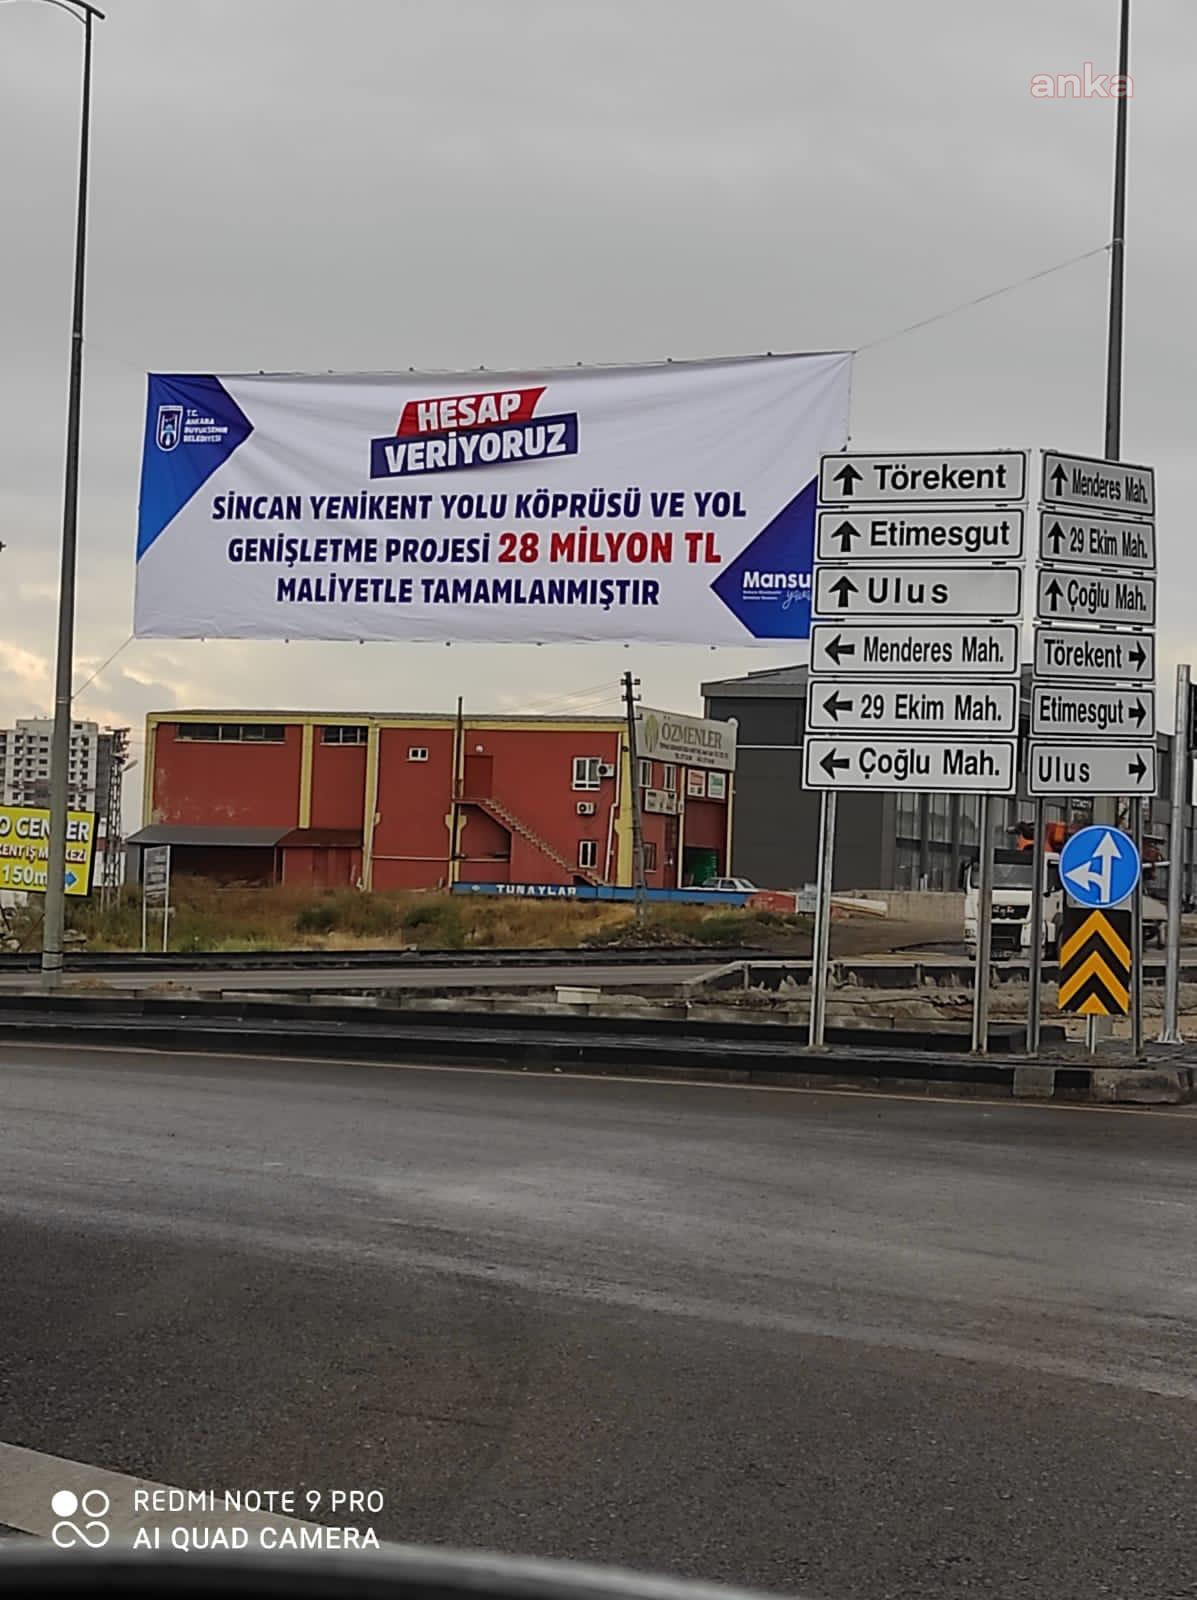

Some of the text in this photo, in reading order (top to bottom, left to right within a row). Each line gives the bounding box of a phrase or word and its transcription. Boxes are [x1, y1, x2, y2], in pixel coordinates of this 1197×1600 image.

[416, 393, 521, 432] HESAP
[384, 424, 566, 473] VERİYORUZ
[873, 463, 1007, 490] Törekent
[1071, 468, 1148, 504] Menderes Mah.
[212, 488, 746, 520] SİNCAN YENİKENT YOLU KÖPRÜSÜ VE YOL
[228, 526, 721, 567] GENİŞLETME PROJESİ 28 MİLYON TL
[870, 521, 1010, 552] Etimesgut
[1069, 527, 1148, 559] 29 Ekim Mah.
[277, 573, 660, 610] MALİYETLE TAMAMLANMIŞTIR
[868, 577, 949, 604] Ulus
[1067, 580, 1146, 613] Çoğlu Mah.
[863, 635, 1004, 663] Menderes Mah.
[1044, 638, 1122, 668] Törekent
[860, 693, 1002, 722] 29 Ekim Mah.
[1040, 697, 1124, 730] Etimesgut
[661, 715, 722, 749] ÖZMENLER
[858, 747, 1000, 780] Çoğlu Mah.
[1038, 756, 1090, 782] Ulus
[15, 817, 89, 841] CENER
[495, 884, 577, 896] TUNAYLAR
